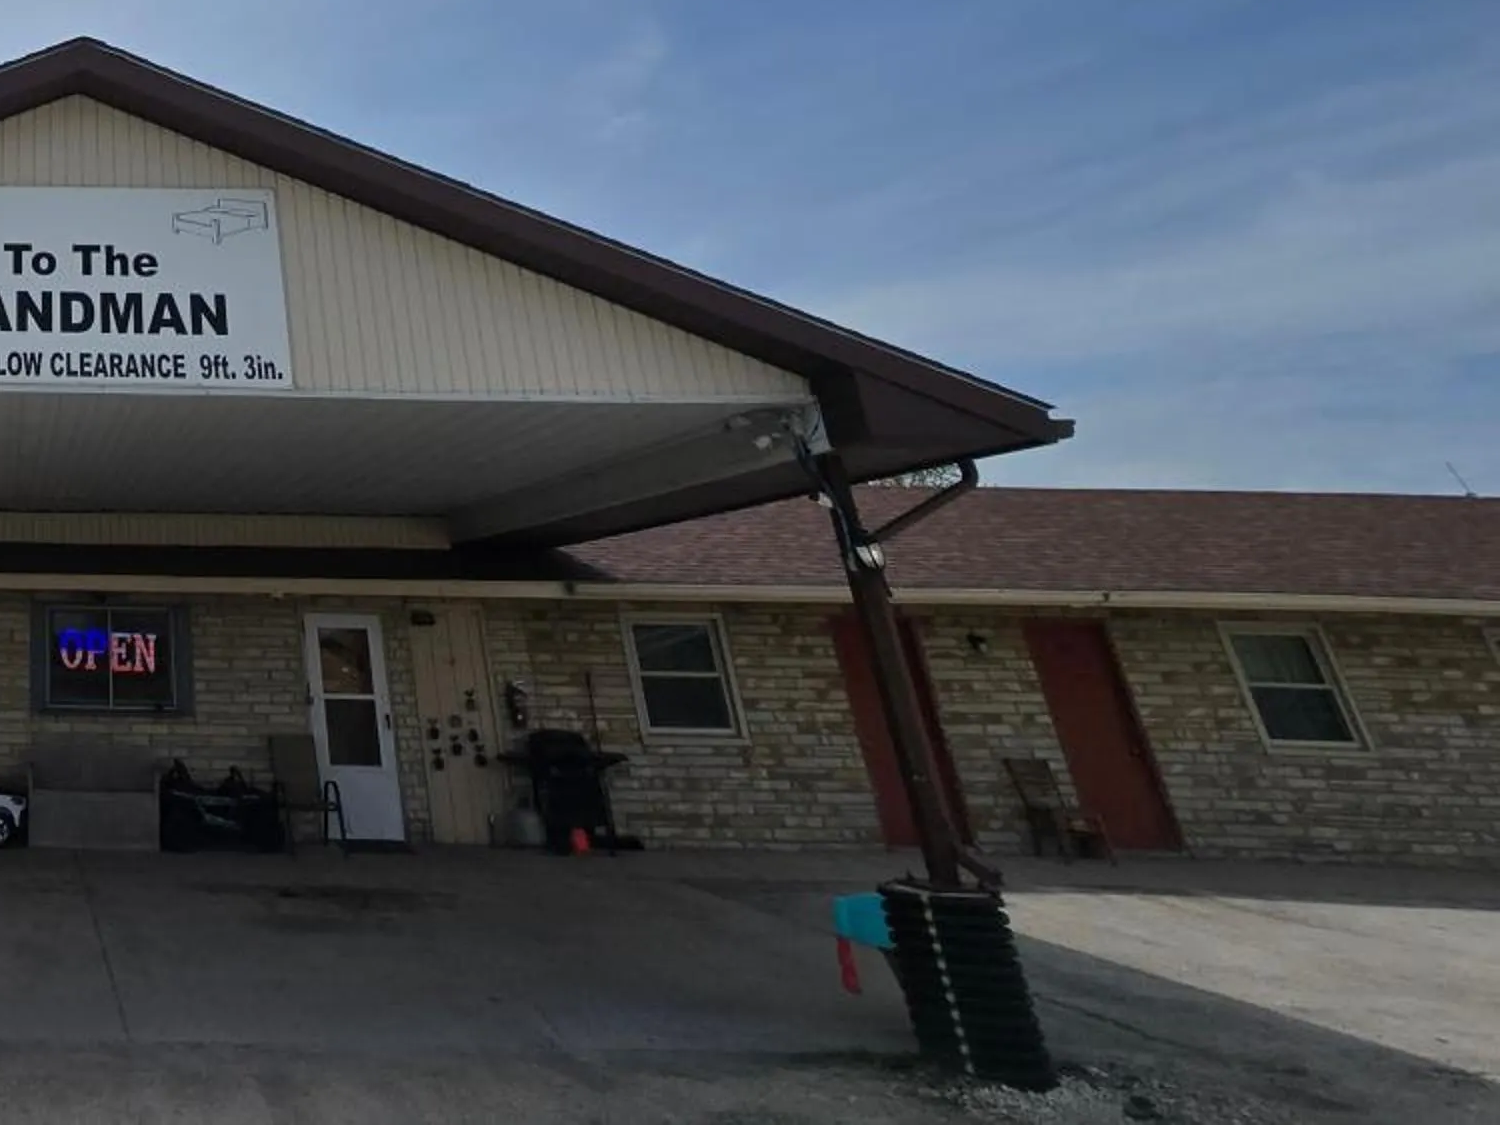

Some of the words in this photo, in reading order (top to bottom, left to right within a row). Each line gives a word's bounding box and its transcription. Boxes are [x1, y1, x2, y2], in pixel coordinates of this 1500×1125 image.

[3, 242, 57, 276] To
[71, 244, 159, 278] The
[49, 352, 187, 380] CLEARANCE
[243, 354, 284, 381] 3in.
[59, 627, 157, 674] OPEN
